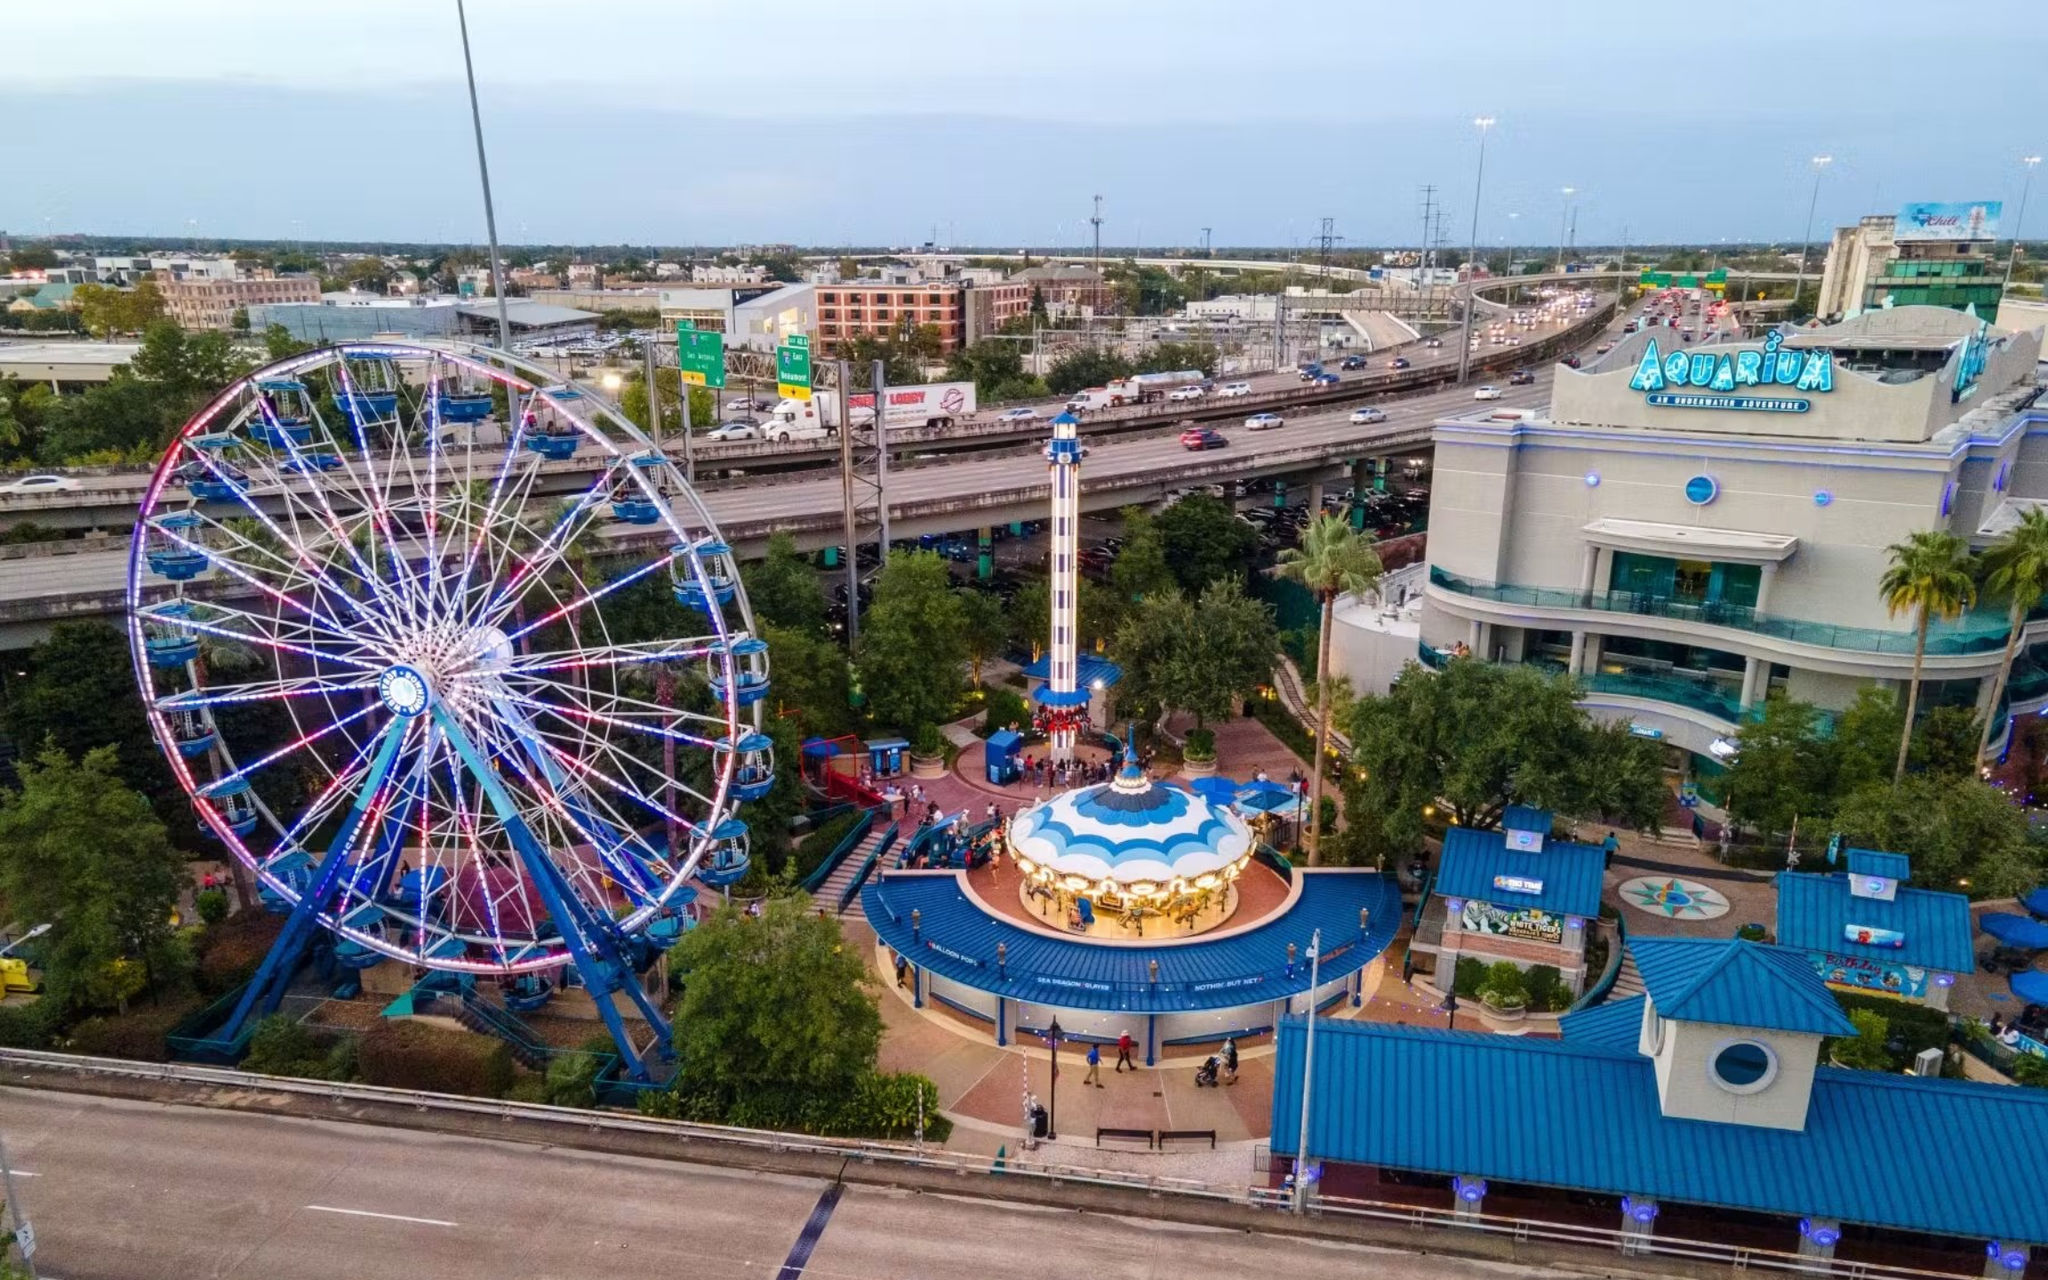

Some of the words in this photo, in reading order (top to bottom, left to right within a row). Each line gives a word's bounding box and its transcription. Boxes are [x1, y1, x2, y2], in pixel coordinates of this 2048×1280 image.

[1629, 330, 1833, 392] AQUARIUM
[1674, 397, 1735, 407] UNDERWATER
[1742, 400, 1799, 410] ADVENTURE
[931, 942, 960, 959] BALLOON
[1037, 976, 1051, 984] SEA
[1226, 979, 1242, 988] BUT
